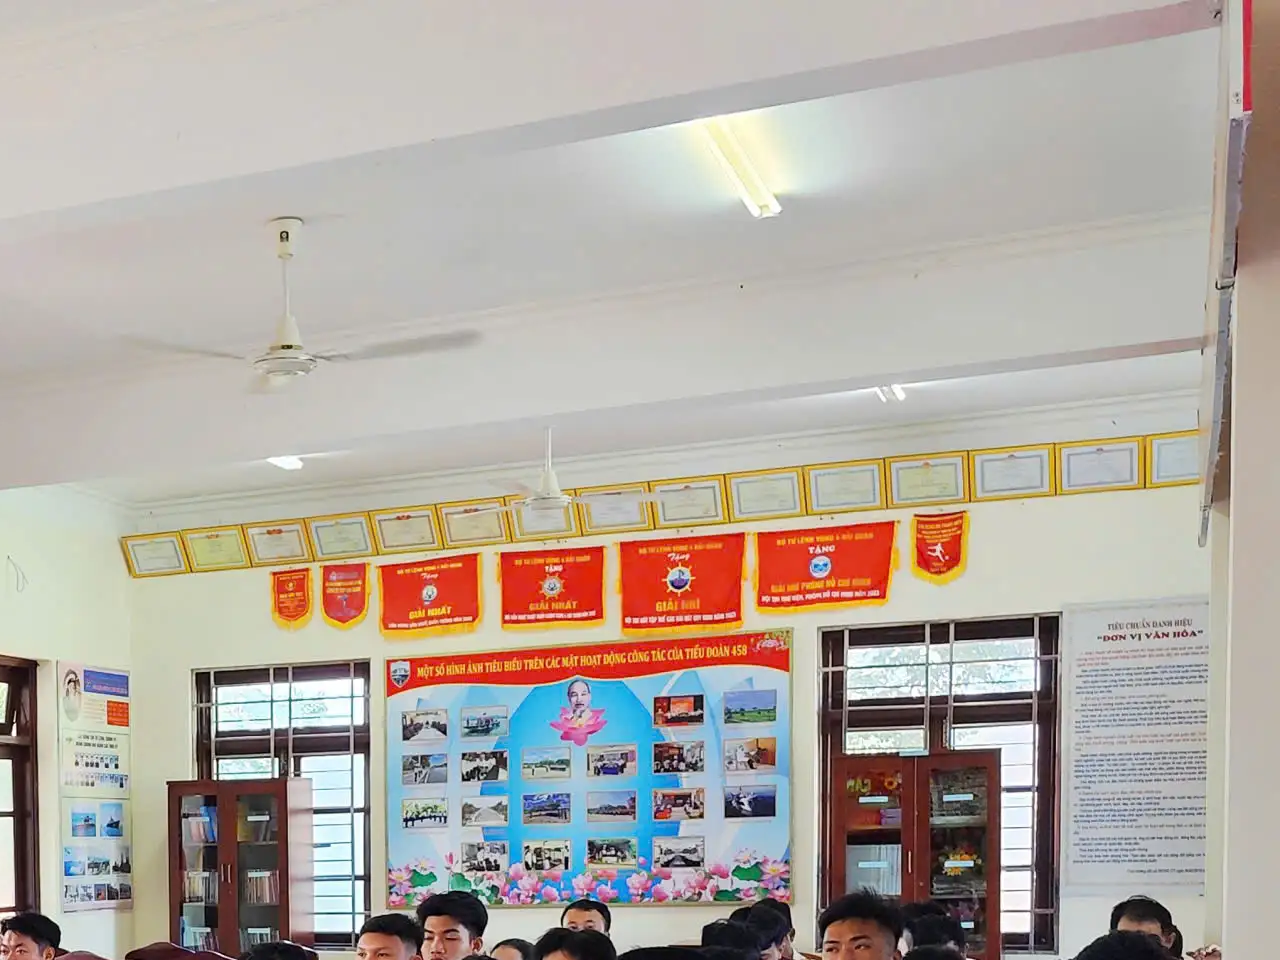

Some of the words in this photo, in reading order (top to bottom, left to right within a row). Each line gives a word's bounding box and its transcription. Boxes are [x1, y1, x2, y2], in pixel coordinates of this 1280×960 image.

[656, 598, 678, 612] GIẢI
[1152, 619, 1173, 629] DANH
[1144, 631, 1170, 640] VĂN
[416, 665, 433, 679] MỘT
[434, 663, 445, 676] SỐ
[446, 661, 466, 676] HÌNH
[467, 660, 483, 674] ẢNH
[485, 659, 503, 673] TIÊU
[504, 656, 522, 672] BIỂU
[524, 656, 544, 670] TRÊN
[545, 655, 561, 669] CÁC
[580, 653, 601, 668] HOẠT
[603, 651, 626, 667] ĐỘNG
[627, 648, 649, 663] CÔNG
[651, 647, 666, 662] TÁC
[667, 645, 683, 661] CỦA
[685, 644, 705, 660] TIỂU
[706, 644, 730, 658] ĐOÀN
[731, 644, 748, 657] 458
